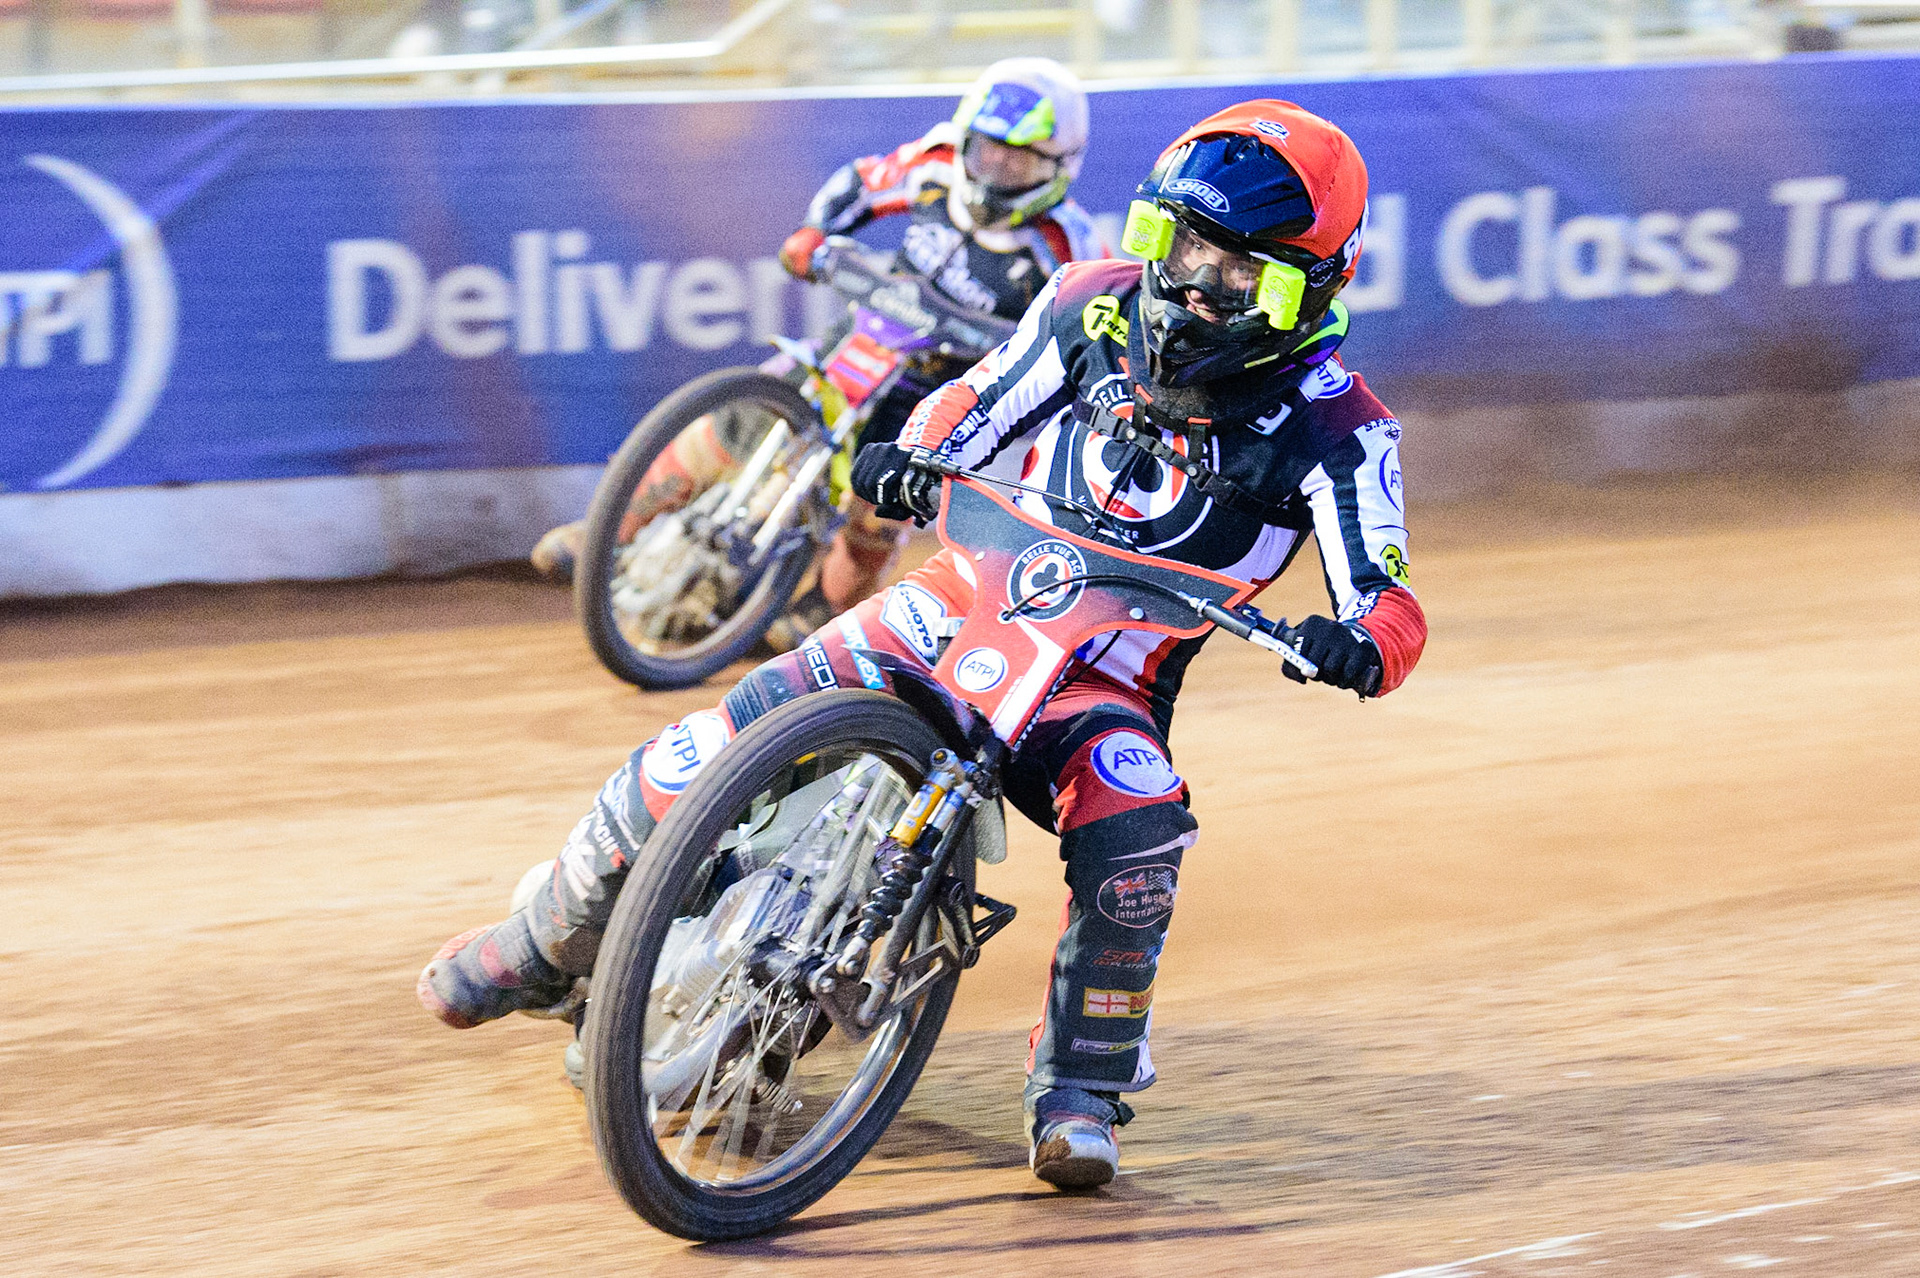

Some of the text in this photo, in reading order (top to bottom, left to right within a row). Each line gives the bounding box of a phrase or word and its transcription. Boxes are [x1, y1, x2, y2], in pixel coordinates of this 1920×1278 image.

[1170, 181, 1225, 209] SHOEI
[1439, 186, 1741, 308] Class
[1021, 544, 1051, 565] BELLE
[1054, 544, 1073, 559] VUE
[964, 659, 997, 680] ATPI
[1113, 747, 1166, 770] ATPI
[1117, 897, 1137, 908] Joe
